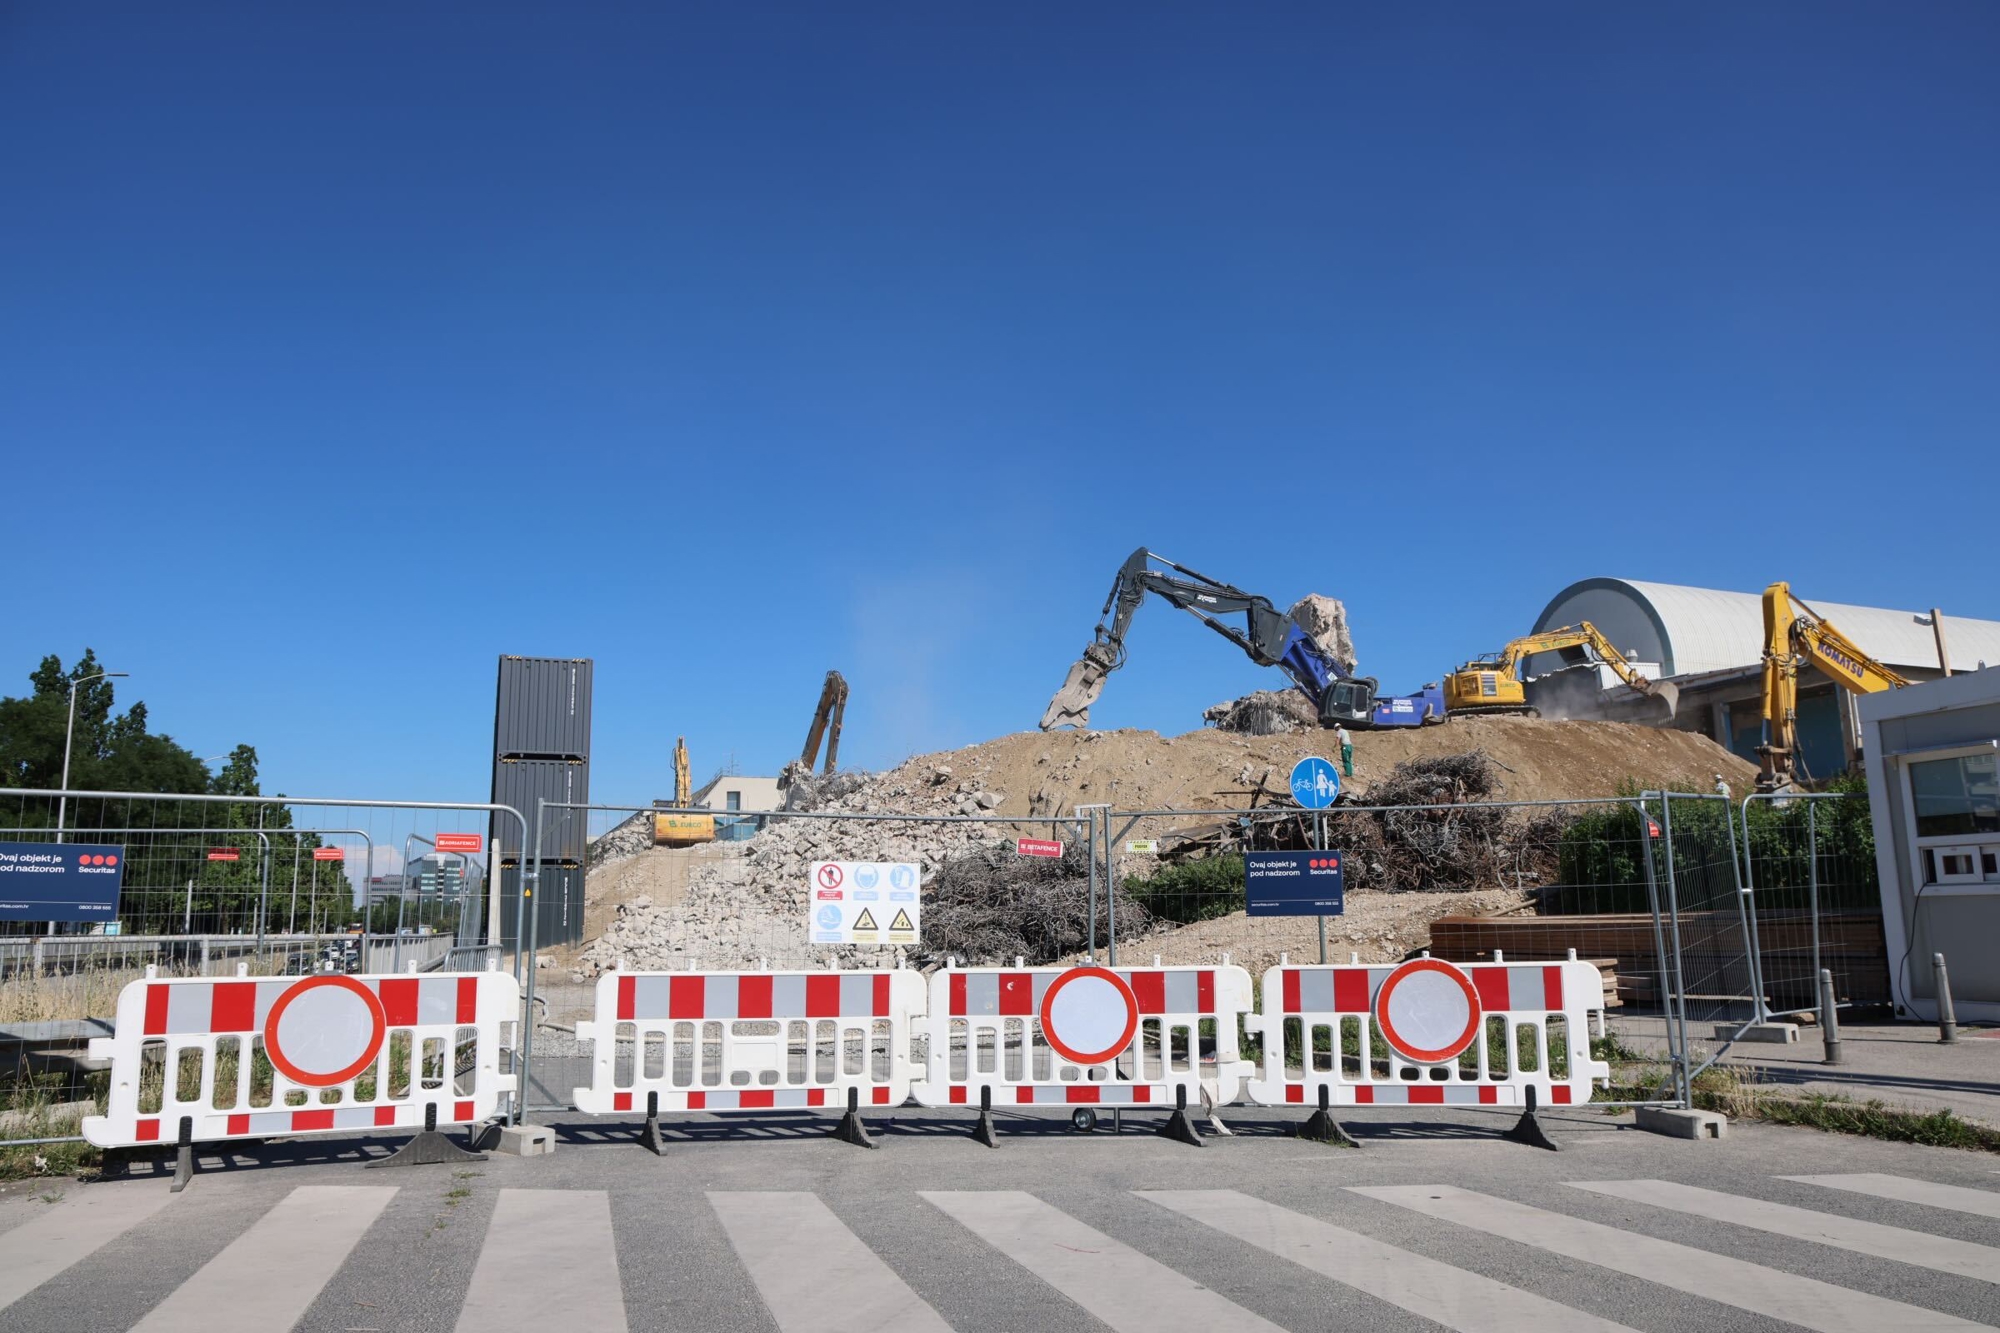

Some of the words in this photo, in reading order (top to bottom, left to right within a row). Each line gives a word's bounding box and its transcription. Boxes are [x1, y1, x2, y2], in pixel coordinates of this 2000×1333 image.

[1817, 642, 1865, 678] KOMATSU
[1027, 844, 1059, 853] BETAFENCE
[20, 854, 51, 864] objekt
[52, 855, 62, 864] je
[0, 864, 14, 872] od
[15, 864, 65, 874] nadzorom
[78, 866, 116, 874] Securitas
[1250, 861, 1266, 869] Ovaj
[1267, 861, 1289, 869] objekt
[1290, 861, 1297, 869] je
[1250, 870, 1264, 878] pod
[1265, 868, 1300, 877] nadzorom
